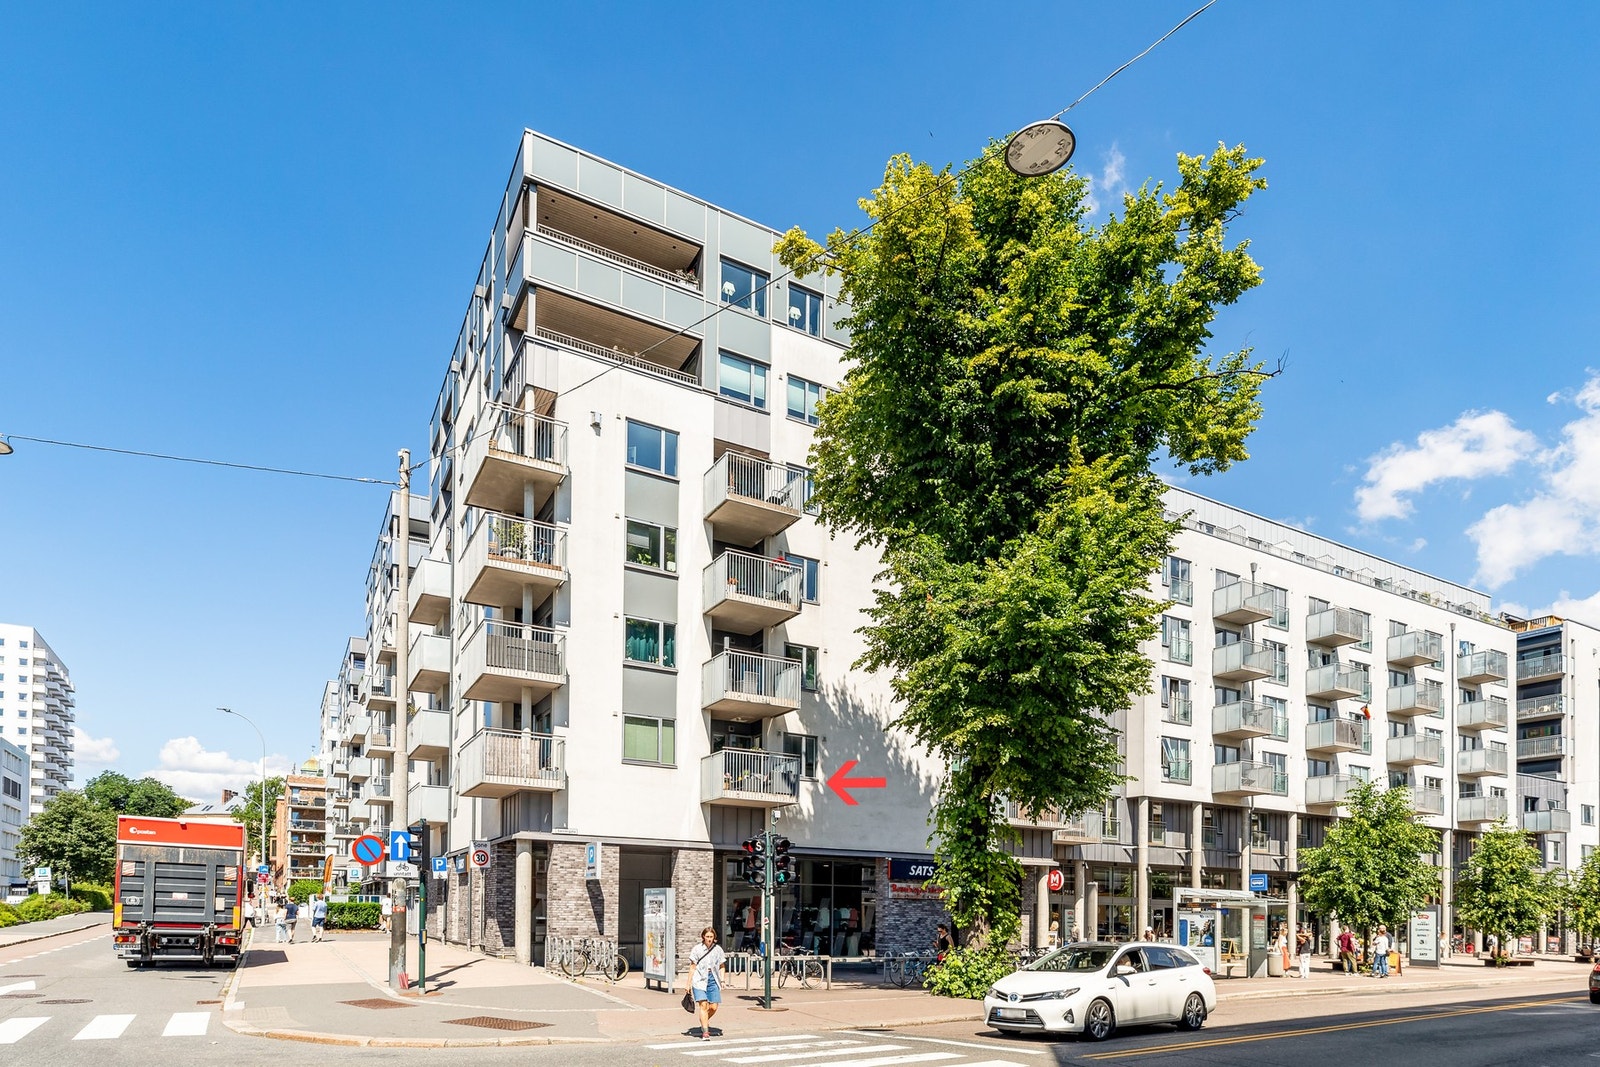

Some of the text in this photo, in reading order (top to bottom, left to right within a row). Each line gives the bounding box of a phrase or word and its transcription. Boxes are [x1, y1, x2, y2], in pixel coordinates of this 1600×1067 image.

[475, 853, 486, 862] 30
[435, 859, 444, 870] P
[909, 865, 934, 876] SATS
